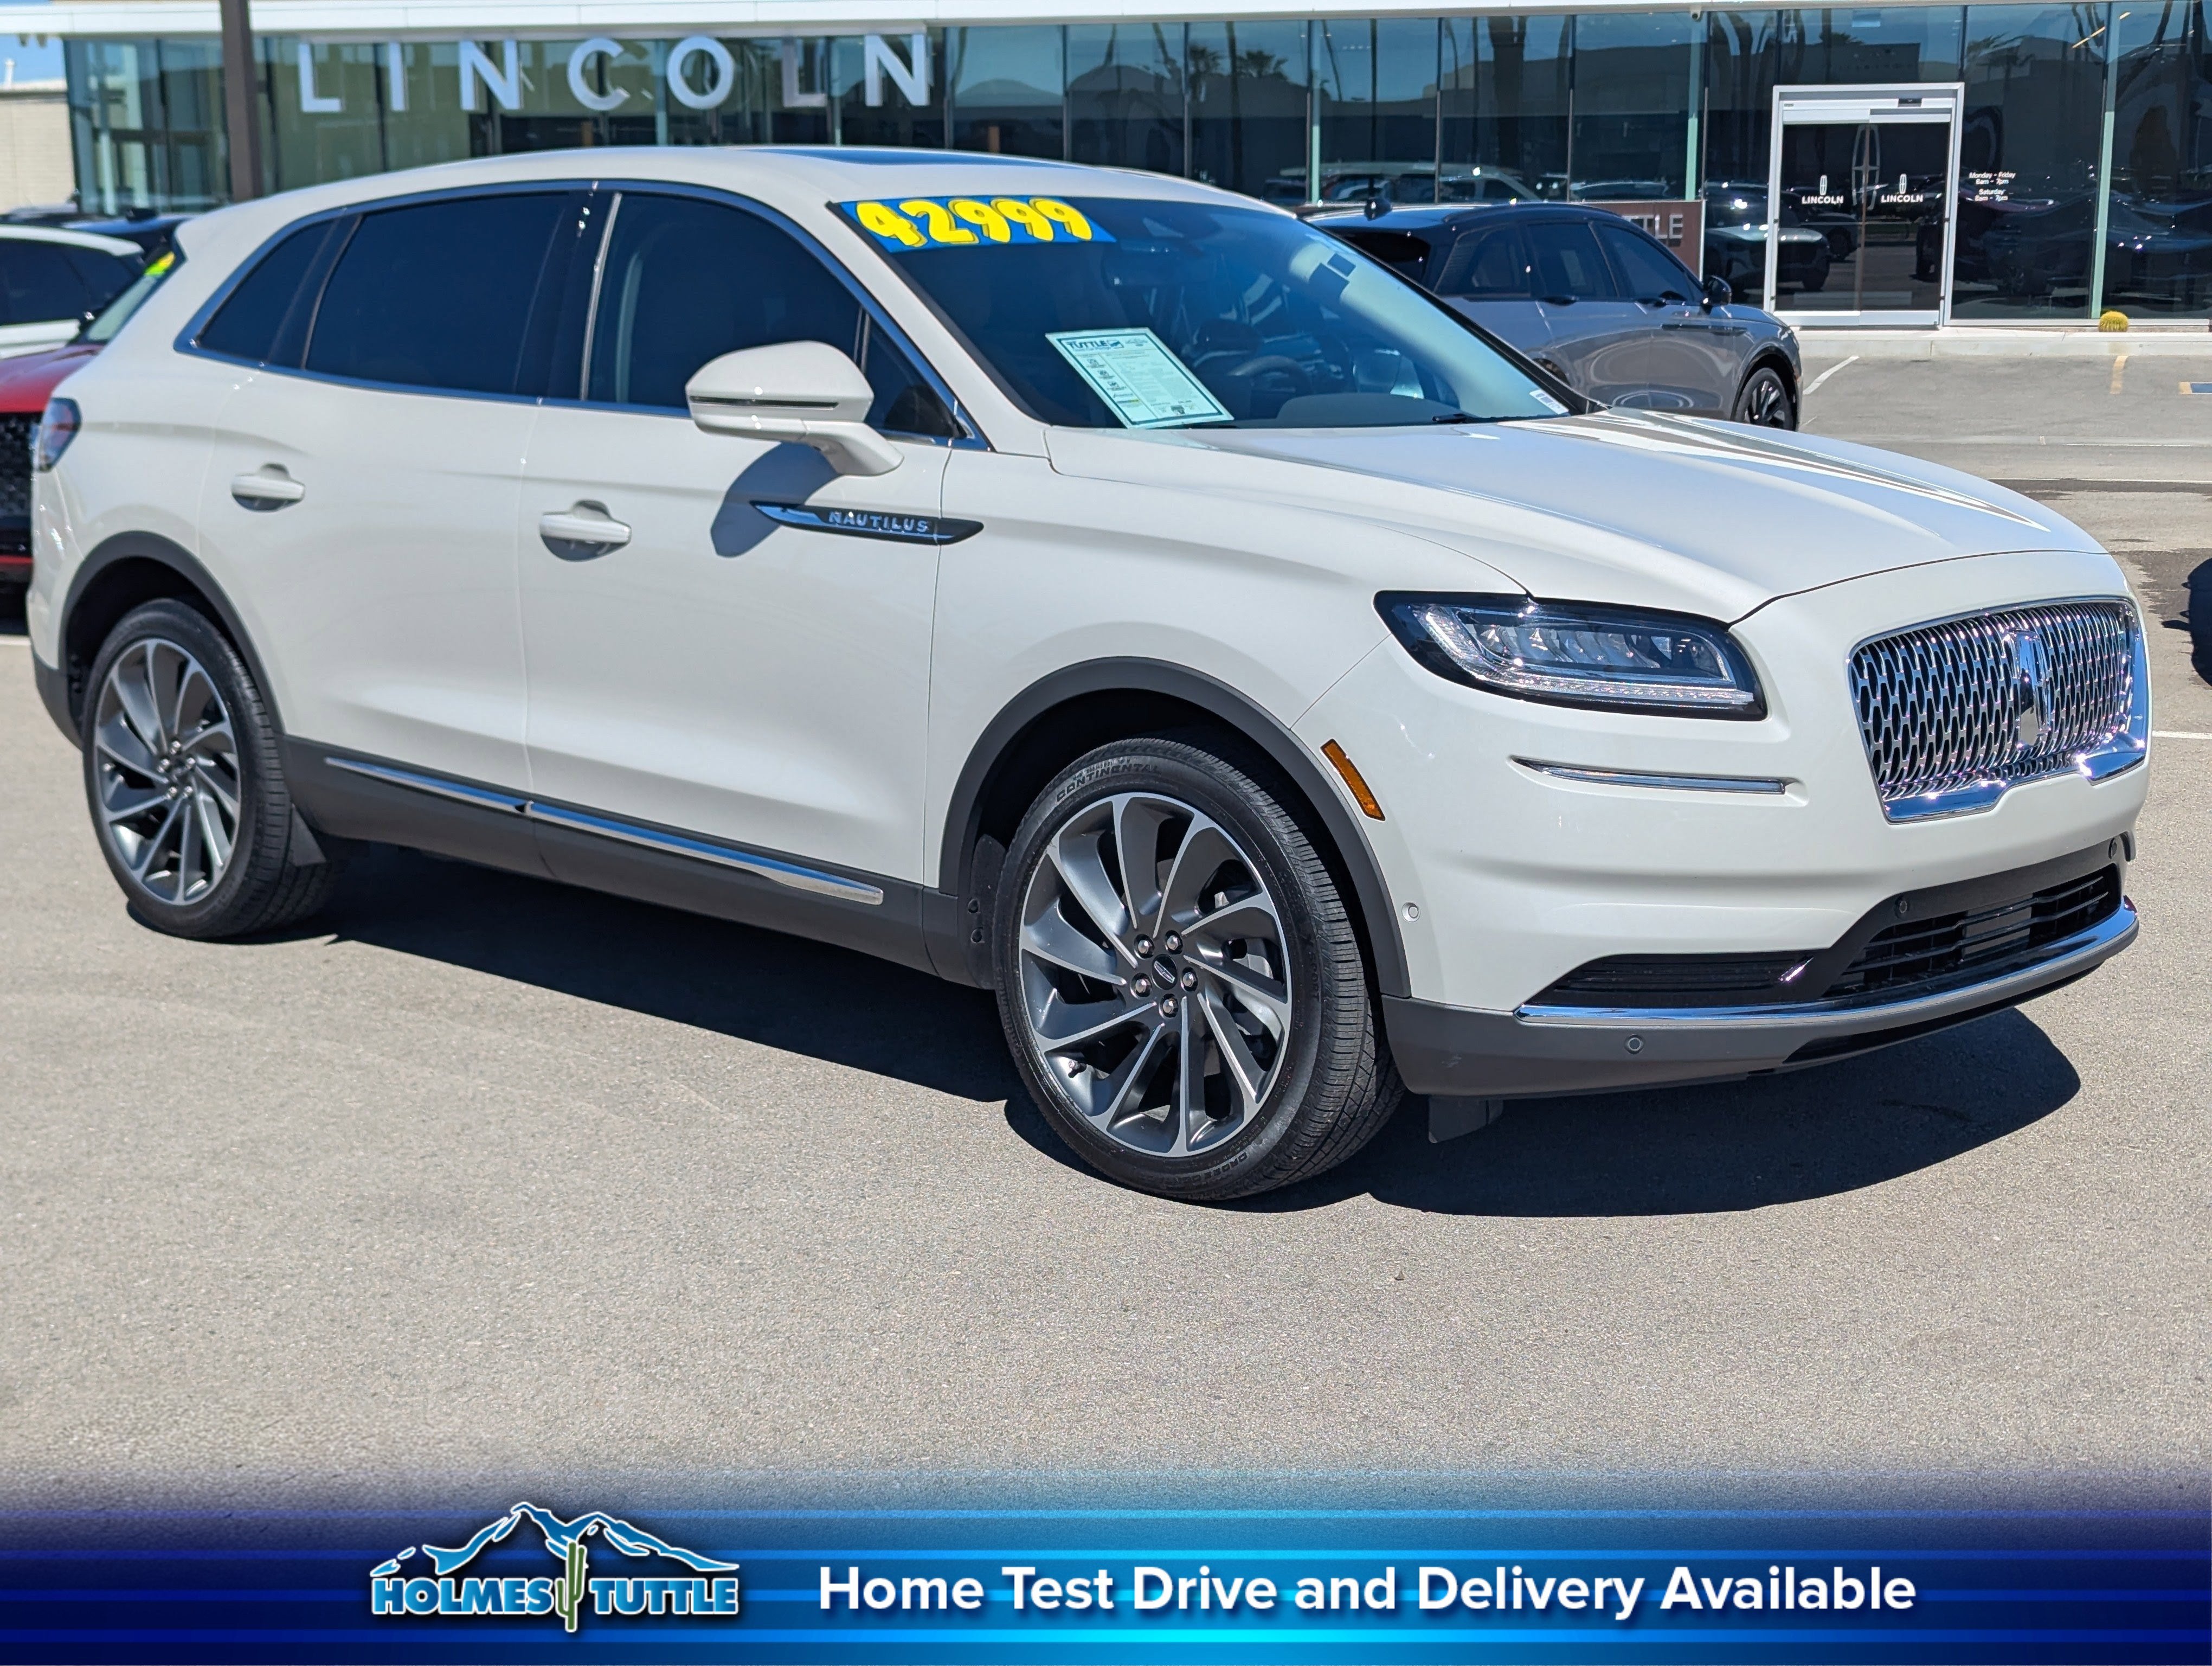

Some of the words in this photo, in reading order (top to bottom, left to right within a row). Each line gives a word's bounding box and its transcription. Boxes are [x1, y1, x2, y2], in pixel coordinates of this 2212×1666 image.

[298, 34, 930, 112] LINCOLN
[1998, 171, 2016, 179] Friday
[1801, 195, 1844, 204] LINCOLN
[1881, 194, 1924, 203] LINCOLN
[856, 198, 1093, 248] 42999
[1066, 339, 1108, 350] TUTTLE
[828, 511, 928, 533] NAUTILUS
[1056, 763, 1162, 803] CONTINENTAL
